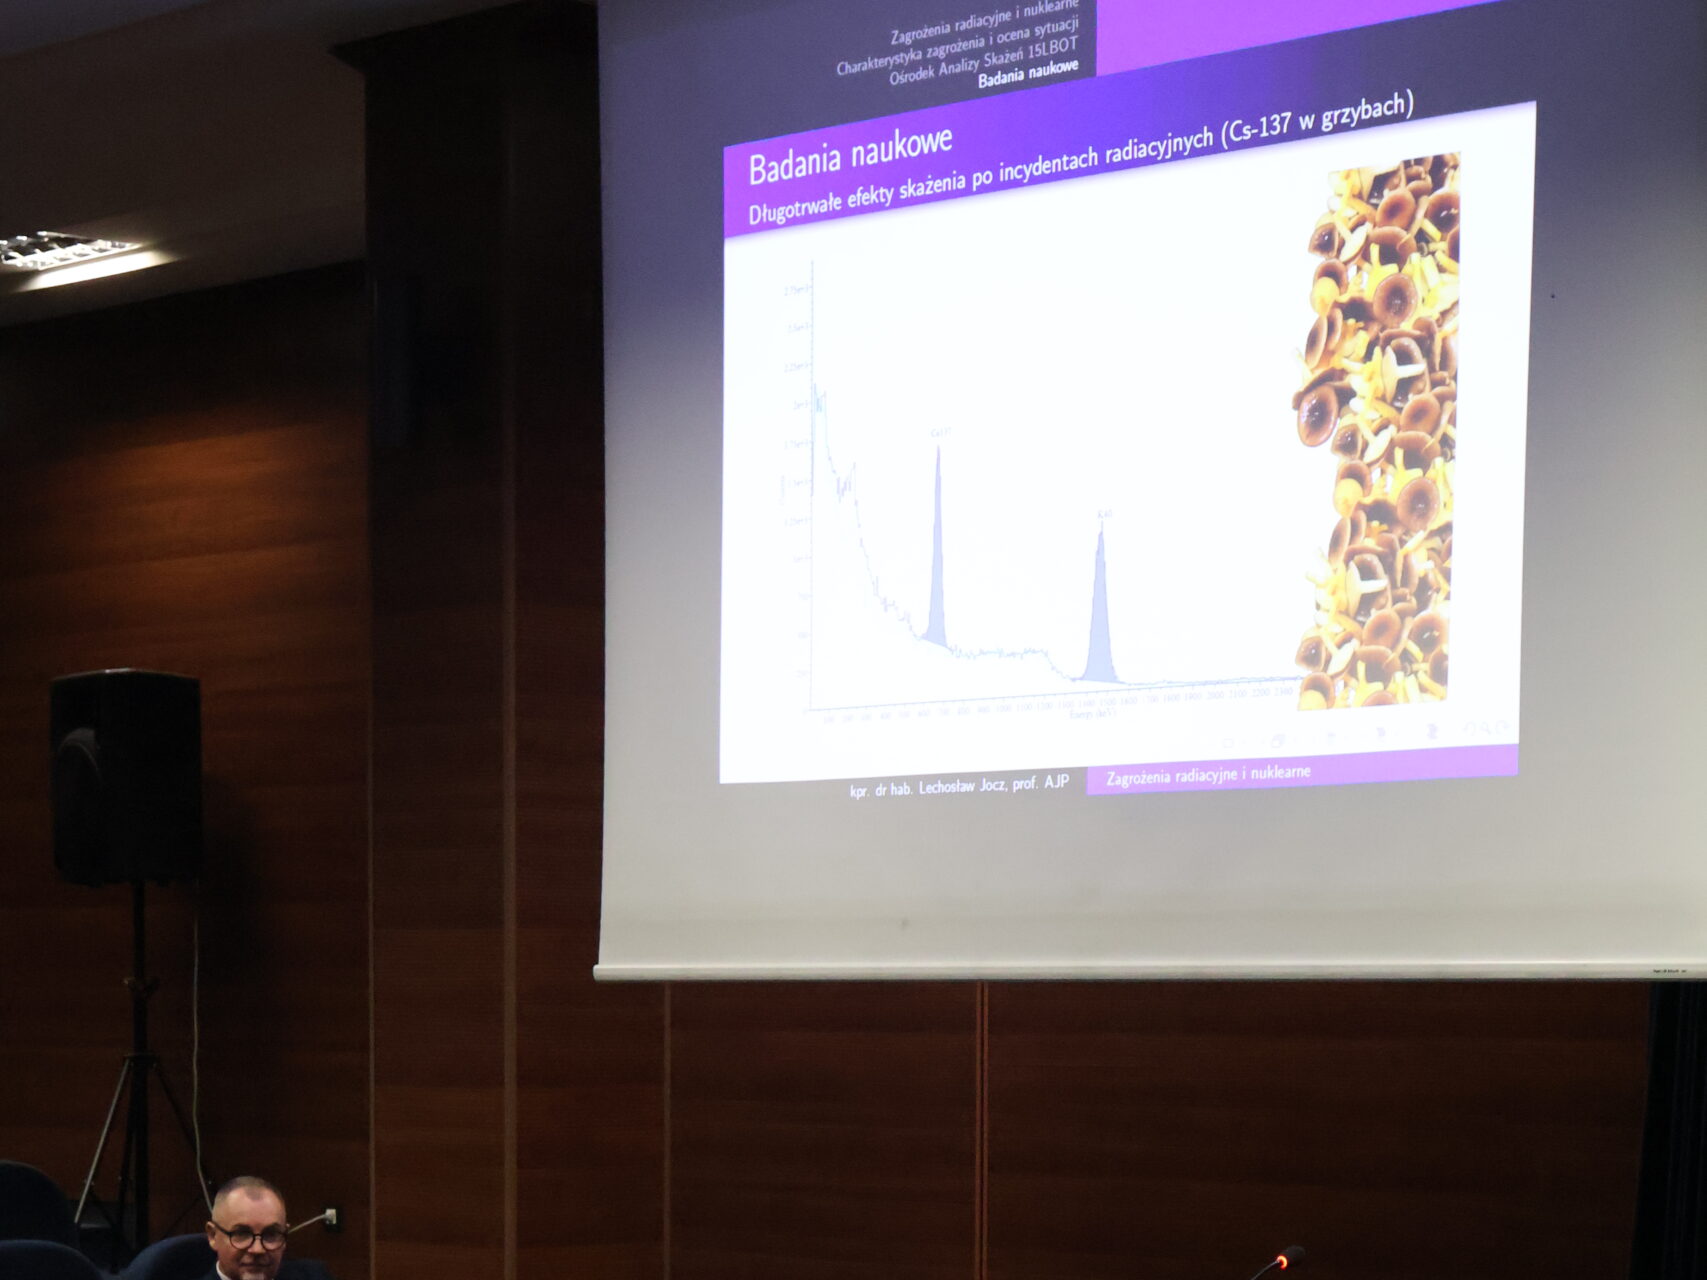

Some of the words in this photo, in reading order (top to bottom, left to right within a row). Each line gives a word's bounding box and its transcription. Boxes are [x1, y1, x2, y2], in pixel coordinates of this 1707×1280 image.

[837, 48, 922, 76] Charakterystyka
[926, 35, 985, 59] zagrożenia
[997, 27, 1030, 45] ocena
[1034, 14, 1079, 39] sytuacji
[891, 22, 950, 46] Zagrożenia
[955, 10, 1012, 33] radiacyjne
[889, 66, 934, 86] Ośrodek
[939, 57, 980, 79] Analizy
[984, 48, 1024, 67] Skażeń
[1027, 35, 1079, 60] 15LBOT
[978, 66, 1024, 89] Badania
[1029, 59, 1079, 79] naukowe
[749, 192, 842, 224] Długotrwałe
[848, 185, 894, 208] efekty
[899, 170, 966, 199] skażenia
[972, 170, 993, 190] po
[1000, 146, 1098, 182] incydentach
[1105, 126, 1214, 164] radiacyjnych
[1221, 112, 1292, 150] (Cs-137
[1299, 114, 1315, 130] w
[1322, 89, 1414, 132] grzybach)
[750, 142, 841, 185] Badania
[852, 128, 953, 167] naukowe
[875, 784, 887, 796] dr
[890, 783, 913, 795] hab.
[919, 778, 976, 795] Lechosław
[980, 777, 1008, 792] Jocz,
[1013, 775, 1038, 792] prof.
[1044, 773, 1070, 788] AJP
[1106, 770, 1171, 789] Zagrożenia
[1175, 767, 1238, 784] radiacyjne
[1251, 764, 1311, 779] nuklearne
